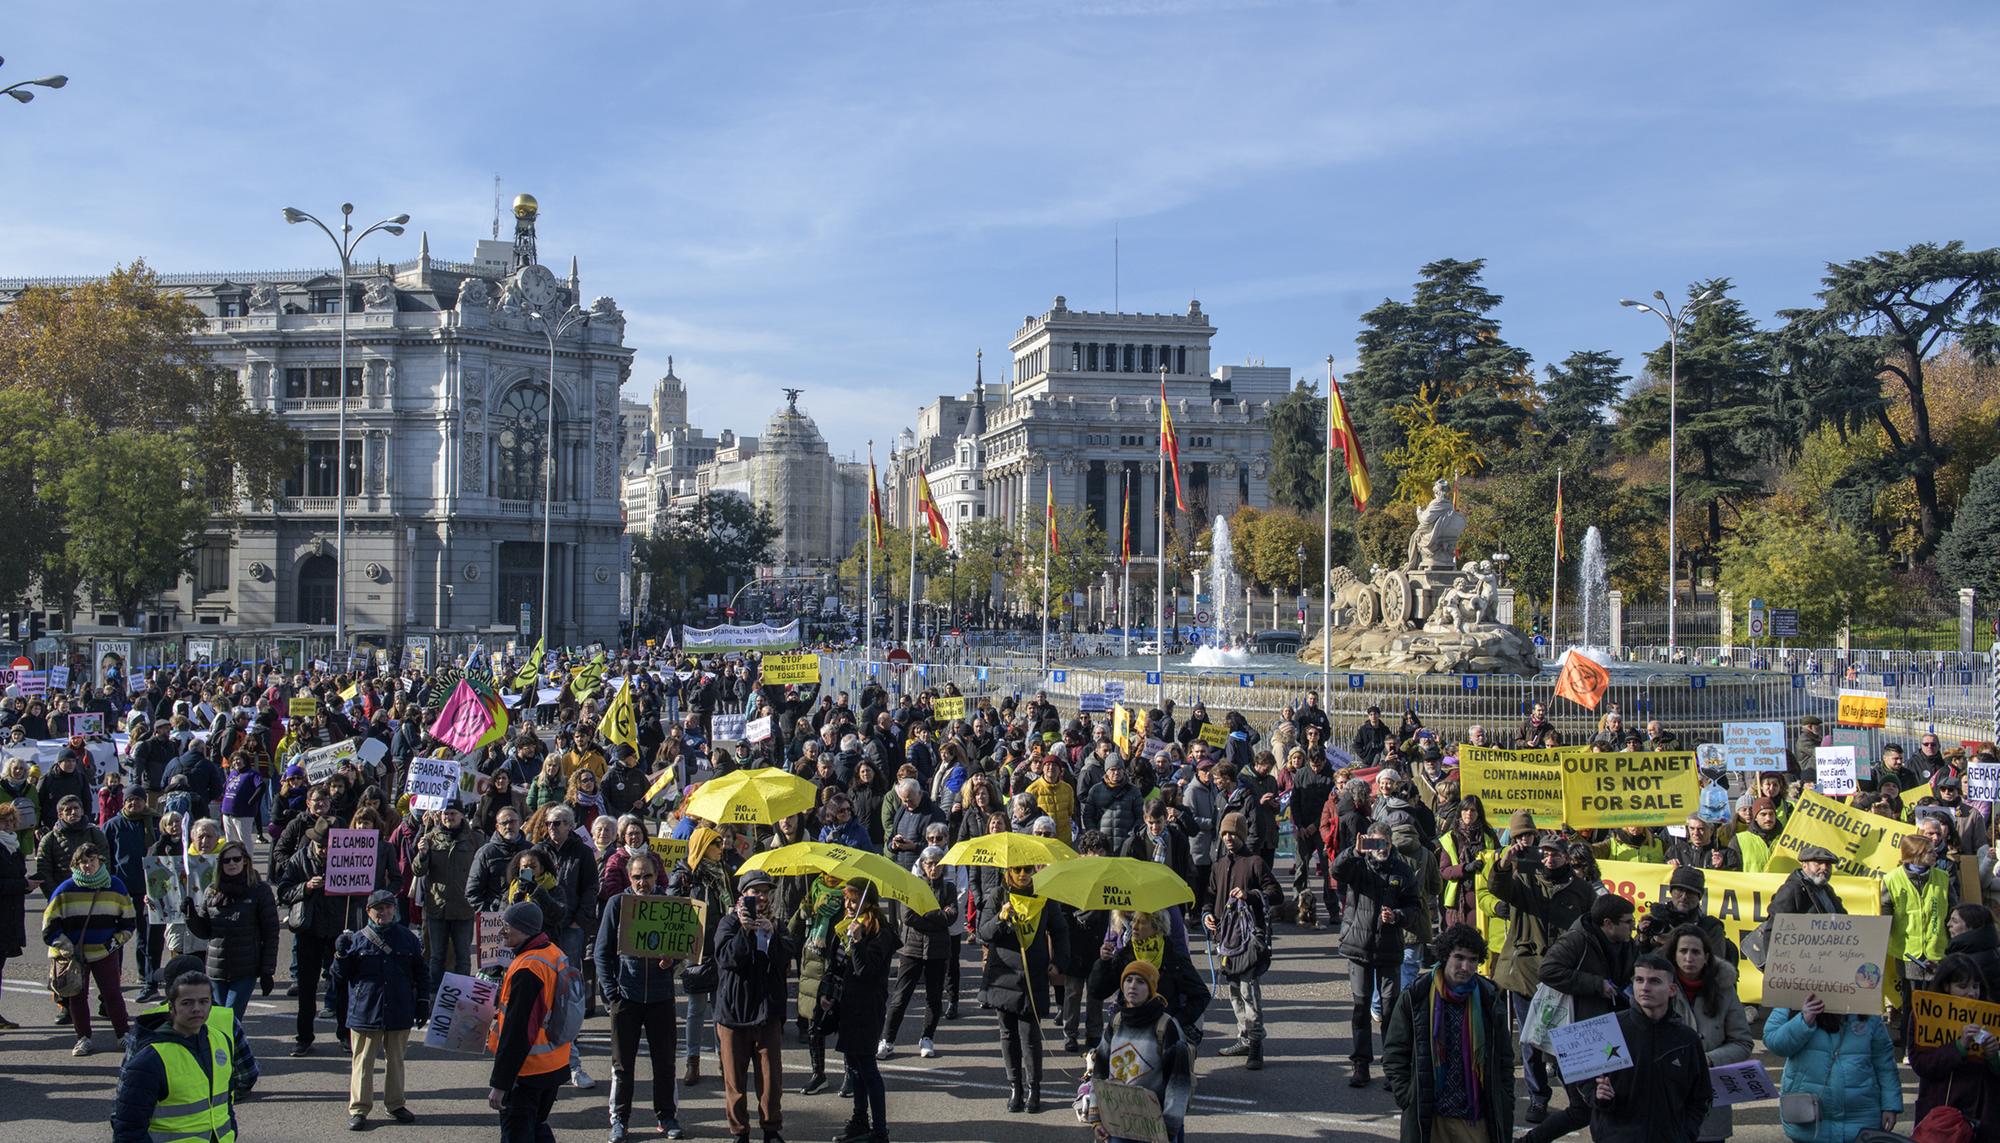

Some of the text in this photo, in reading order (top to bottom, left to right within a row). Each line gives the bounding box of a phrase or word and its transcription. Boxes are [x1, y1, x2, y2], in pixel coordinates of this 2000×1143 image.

[98, 643, 129, 652] LOEWE
[781, 656, 803, 664] STOP
[763, 662, 818, 672] COMBUSTIBLES
[1841, 705, 1850, 716] NO
[1851, 705, 1860, 719] hay
[1860, 706, 1878, 720] planeta
[1468, 750, 1517, 762] TENEMOS
[1521, 753, 1549, 763] POCA
[1817, 758, 1826, 766] We
[1563, 756, 1693, 773] OUR PLANET
[1483, 769, 1561, 781] CONTAMINADA
[405, 780, 442, 797] EXPOLIOS
[1596, 776, 1664, 792] IS NOT
[1481, 789, 1503, 800] MAL
[735, 804, 747, 812] NO
[1582, 794, 1683, 811] FOR SALE
[734, 812, 757, 821] TALA
[1797, 798, 1871, 838] PETRÓLEO
[1879, 827, 1887, 843] Y
[331, 836, 375, 849] EL CAMBIO
[656, 842, 672, 854] hay
[674, 844, 686, 852] un
[330, 852, 374, 868] CLIMÁTICO
[971, 855, 994, 863] TALA
[329, 874, 372, 887] NOS MATA.
[1103, 885, 1119, 895] NO
[1102, 895, 1132, 907] TALA
[663, 922, 685, 931] YOUR
[1810, 919, 1852, 931] MENOS
[1774, 933, 1860, 946] RESPONSABLES
[1839, 949, 1865, 962] sufren
[1771, 961, 1796, 974] MÁS
[1768, 976, 1857, 995] CONSECUENCIAS
[438, 985, 462, 1012] NOS
[1915, 998, 1943, 1020] ¡No
[1720, 1075, 1743, 1095] drink
